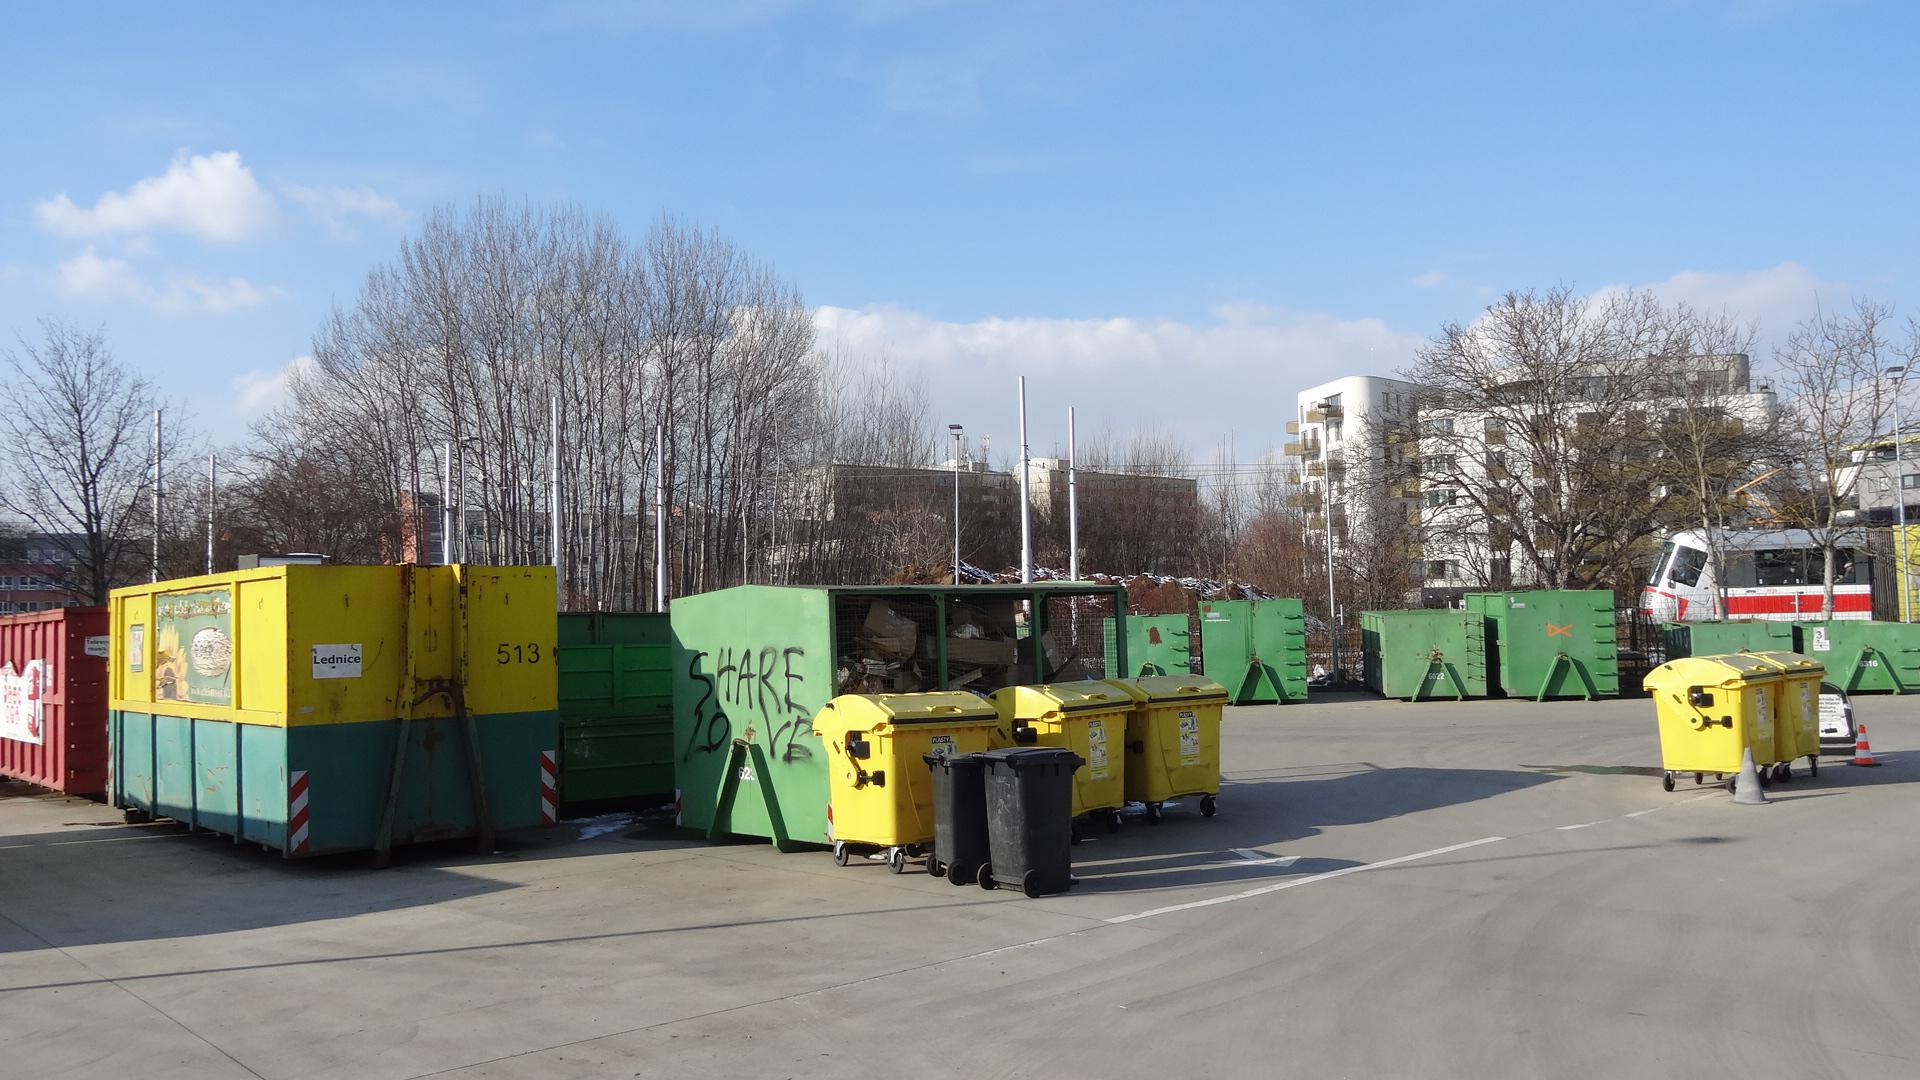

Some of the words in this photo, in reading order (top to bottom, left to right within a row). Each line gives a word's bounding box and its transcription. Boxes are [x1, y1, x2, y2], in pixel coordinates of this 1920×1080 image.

[313, 654, 361, 665] Lednice
[496, 643, 541, 665] 513
[689, 647, 810, 717] SHARE
[932, 736, 950, 744] PLASTY
